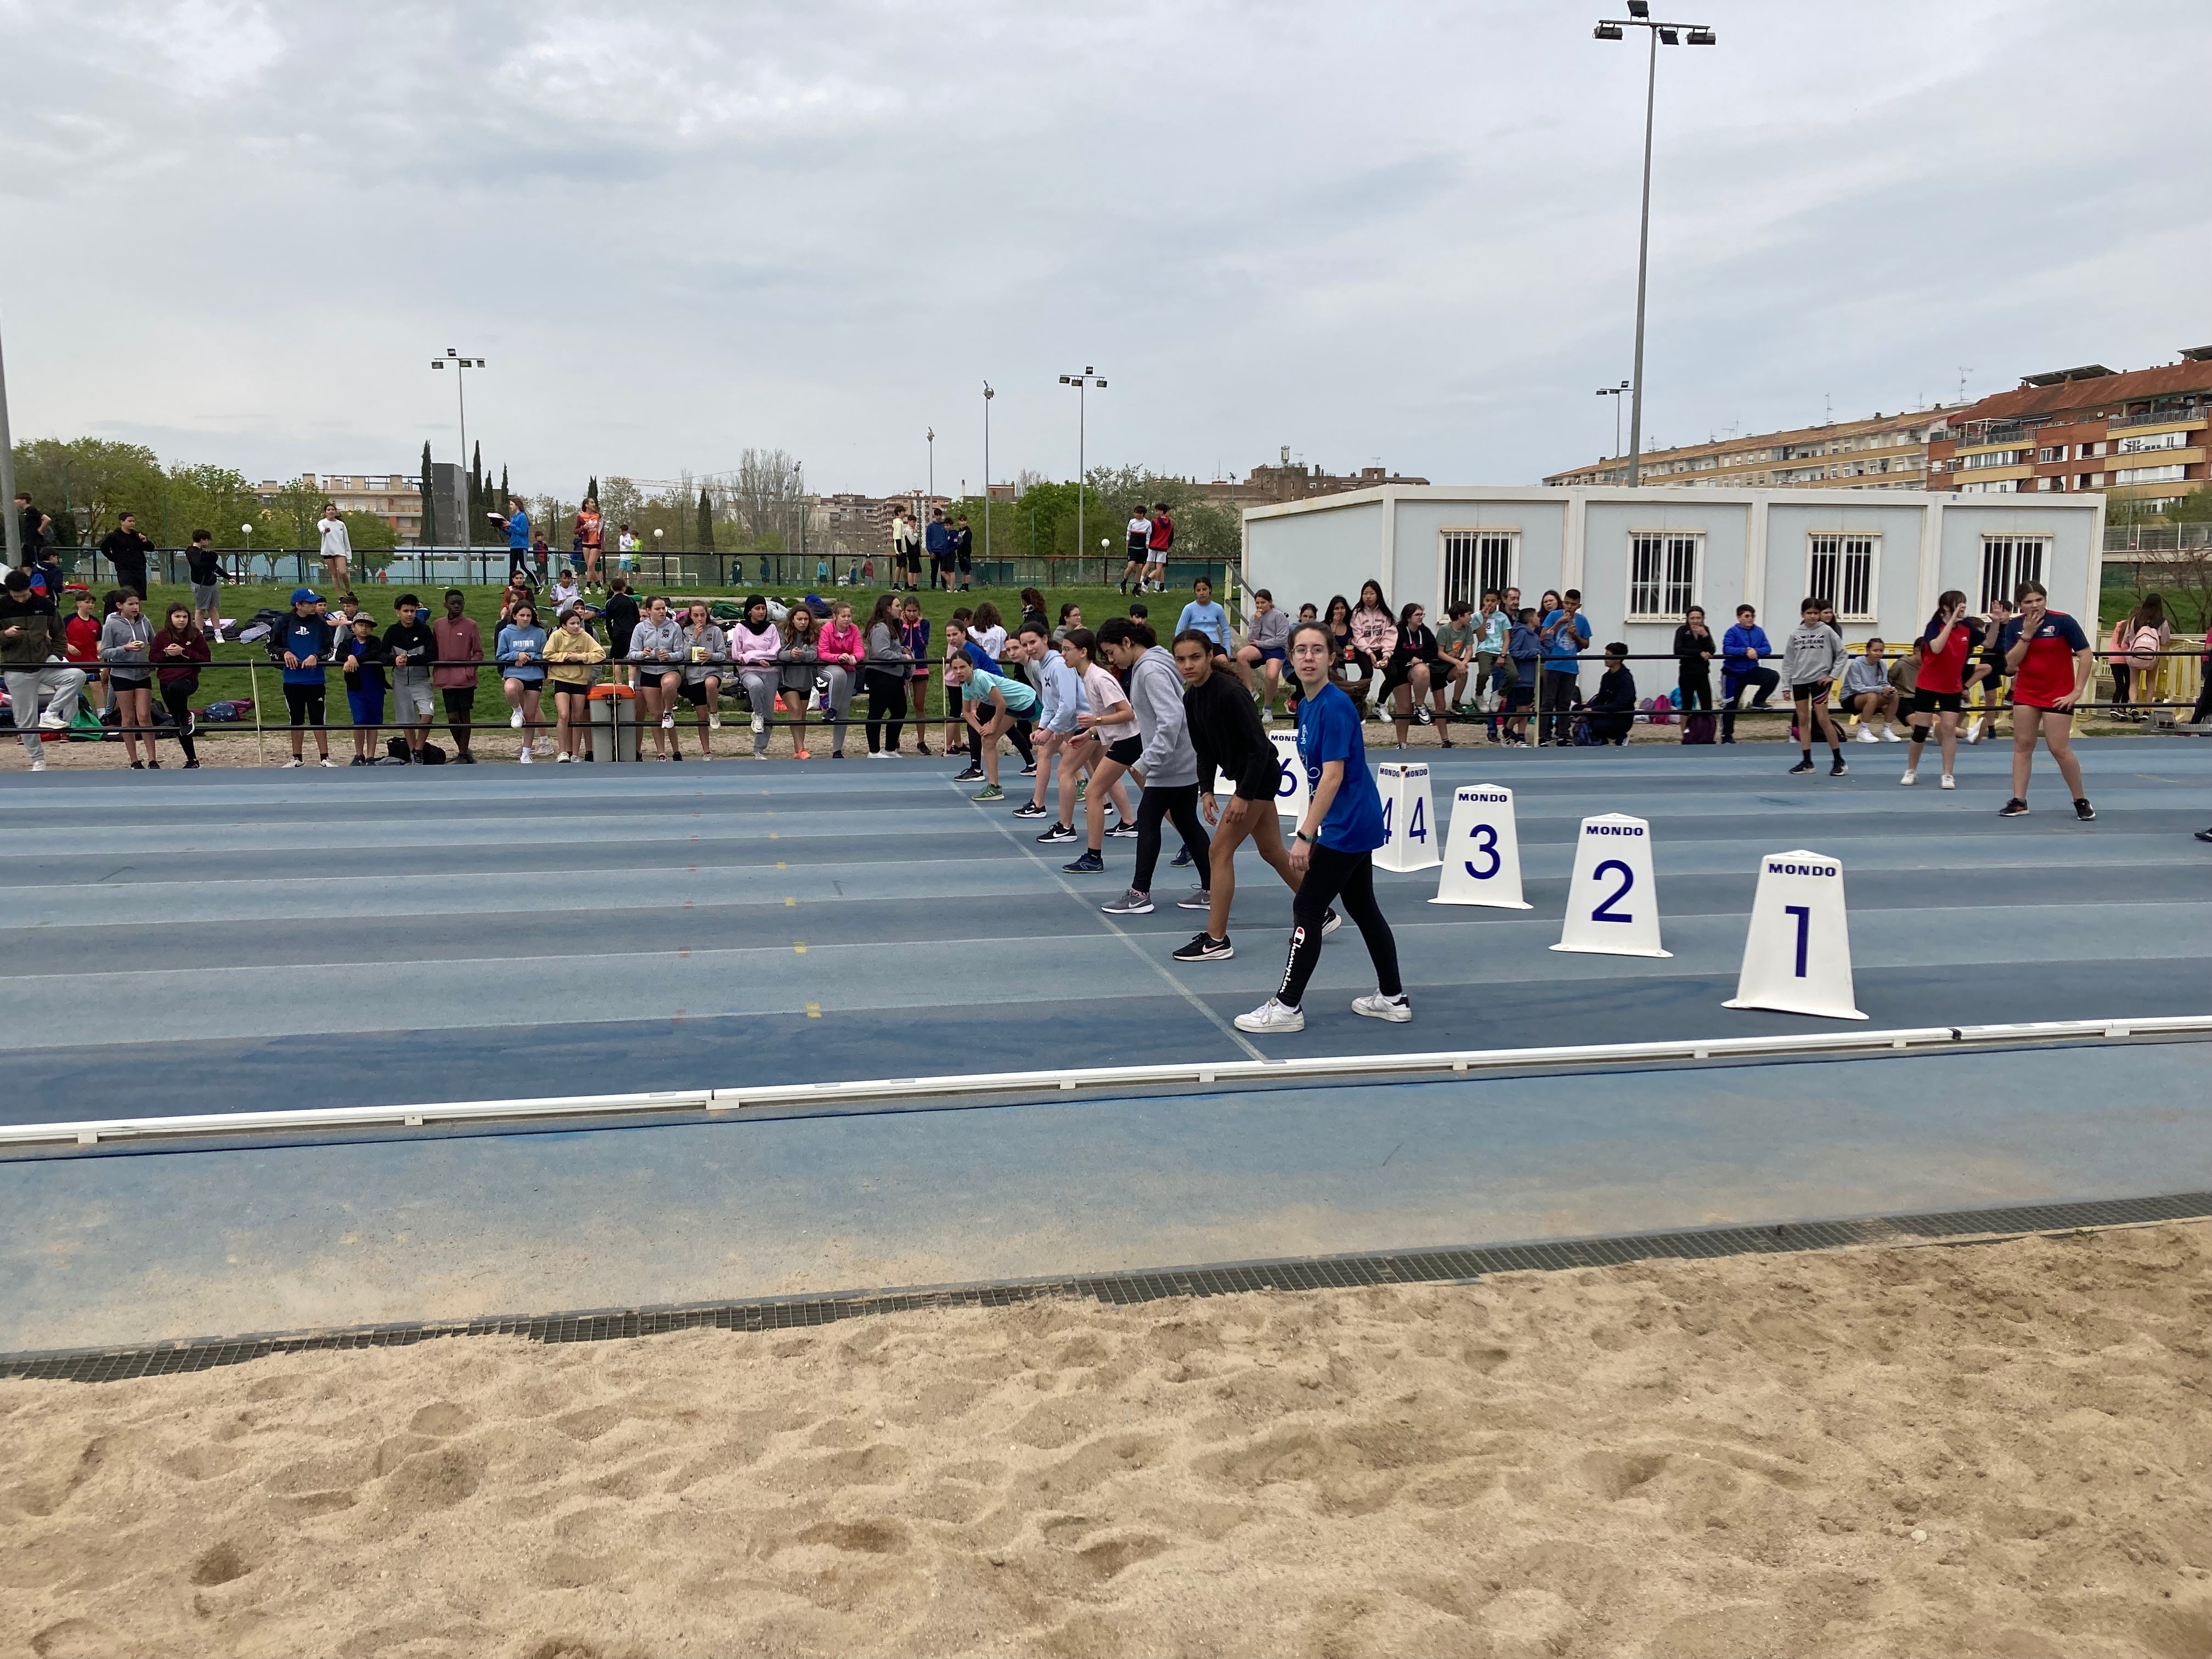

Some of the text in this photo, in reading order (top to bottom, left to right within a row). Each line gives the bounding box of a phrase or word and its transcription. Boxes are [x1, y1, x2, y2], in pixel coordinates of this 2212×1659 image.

[1380, 768, 1400, 778] MONDO
[1405, 769, 1427, 778] MONDO
[1458, 793, 1508, 802] MONDO
[1409, 797, 1426, 844] 4
[1586, 826, 1644, 836] MONDO
[1465, 824, 1500, 879] 3
[1769, 863, 1836, 877] MONDO
[1592, 859, 1634, 923] 2
[1785, 905, 1810, 978] 1
[1279, 926, 1305, 994] Champion
